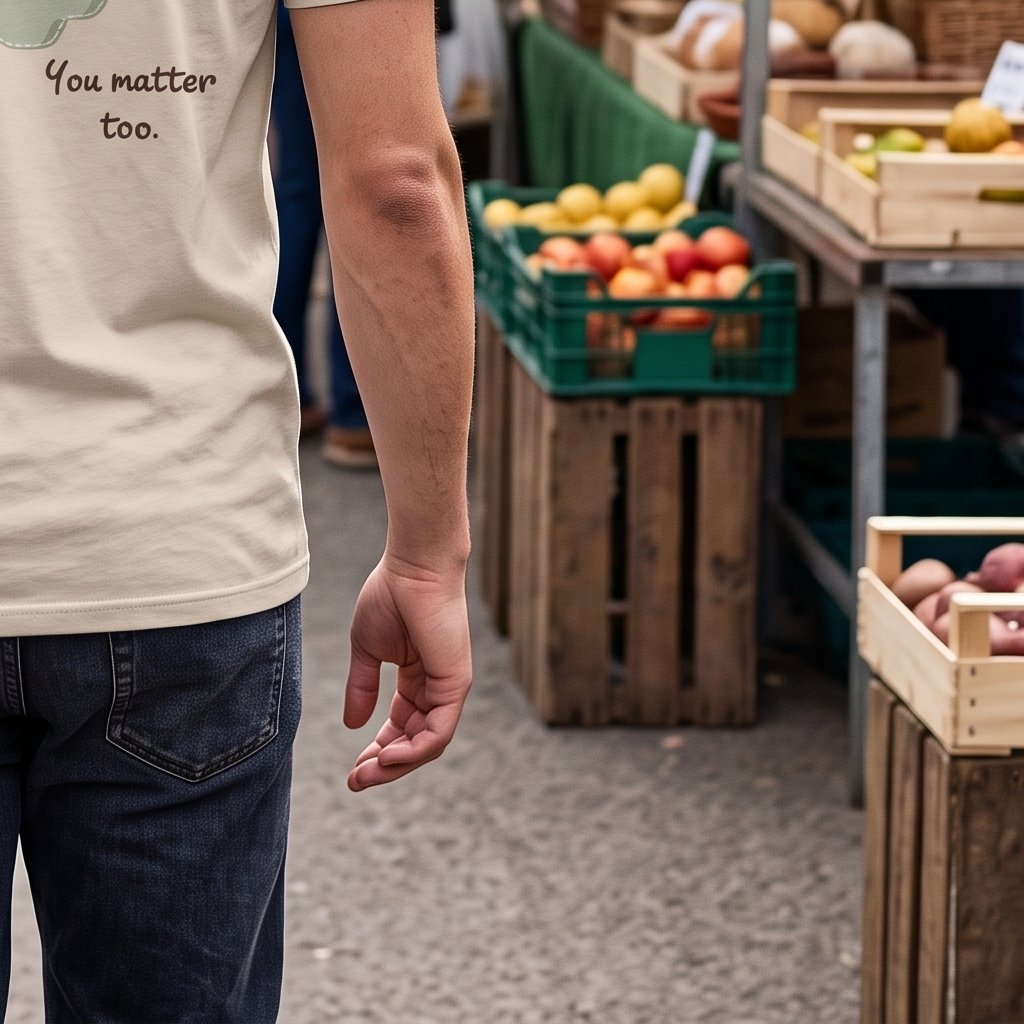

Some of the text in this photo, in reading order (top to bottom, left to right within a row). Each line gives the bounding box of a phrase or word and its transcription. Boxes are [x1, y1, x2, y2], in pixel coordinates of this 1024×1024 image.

[45, 58, 217, 96] You matter
[99, 112, 159, 140] too.
